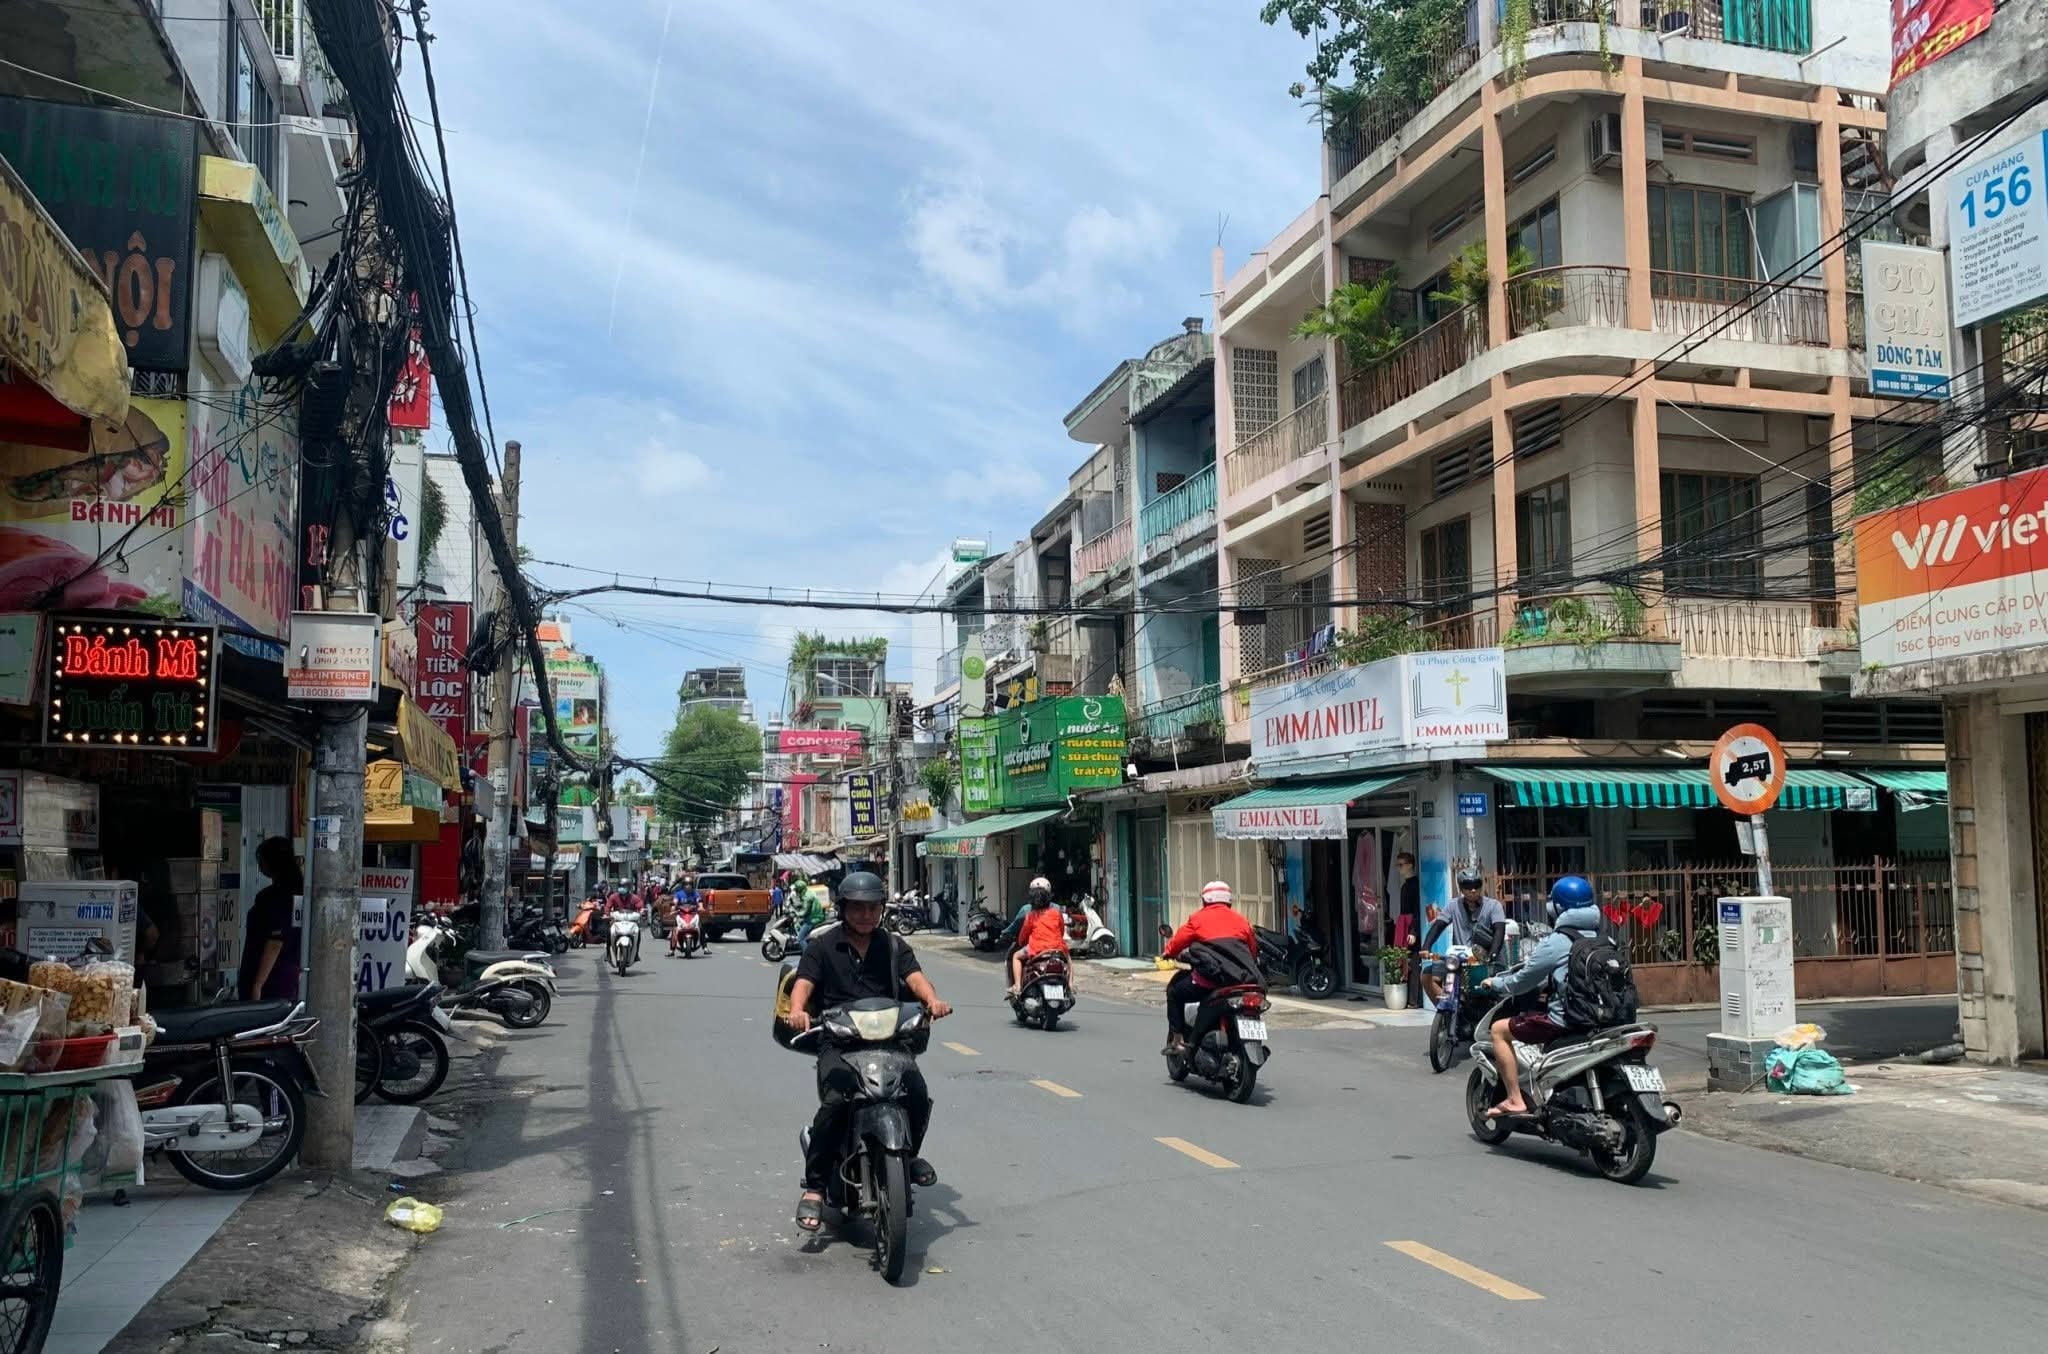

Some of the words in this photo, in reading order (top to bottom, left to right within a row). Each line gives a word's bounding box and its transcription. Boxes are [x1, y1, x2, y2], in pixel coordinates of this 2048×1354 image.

[1966, 170, 1990, 188] CỬA
[1992, 151, 2025, 175] HÀNG
[1960, 165, 2032, 228] 156
[1963, 238, 1988, 253] Internet
[1877, 336, 1913, 365] ĐỒNG
[1916, 343, 1942, 369] TÂM
[1896, 610, 1931, 633] ĐIỂM
[1936, 604, 1980, 626] CUNG
[1985, 593, 2018, 616] CẤP
[65, 635, 149, 676] Bánh
[156, 639, 198, 678] Mì
[319, 671, 367, 680] INTERNET
[420, 676, 463, 700] LỘC
[1265, 697, 1384, 747] EMMANUEL
[1416, 722, 1504, 737] EMMANUEL
[1742, 759, 1766, 773] 2,5T
[854, 801, 871, 810] VALI
[856, 812, 869, 823] TÚI
[1239, 808, 1323, 827] EMMANUEL
[853, 823, 875, 834] XÁCH
